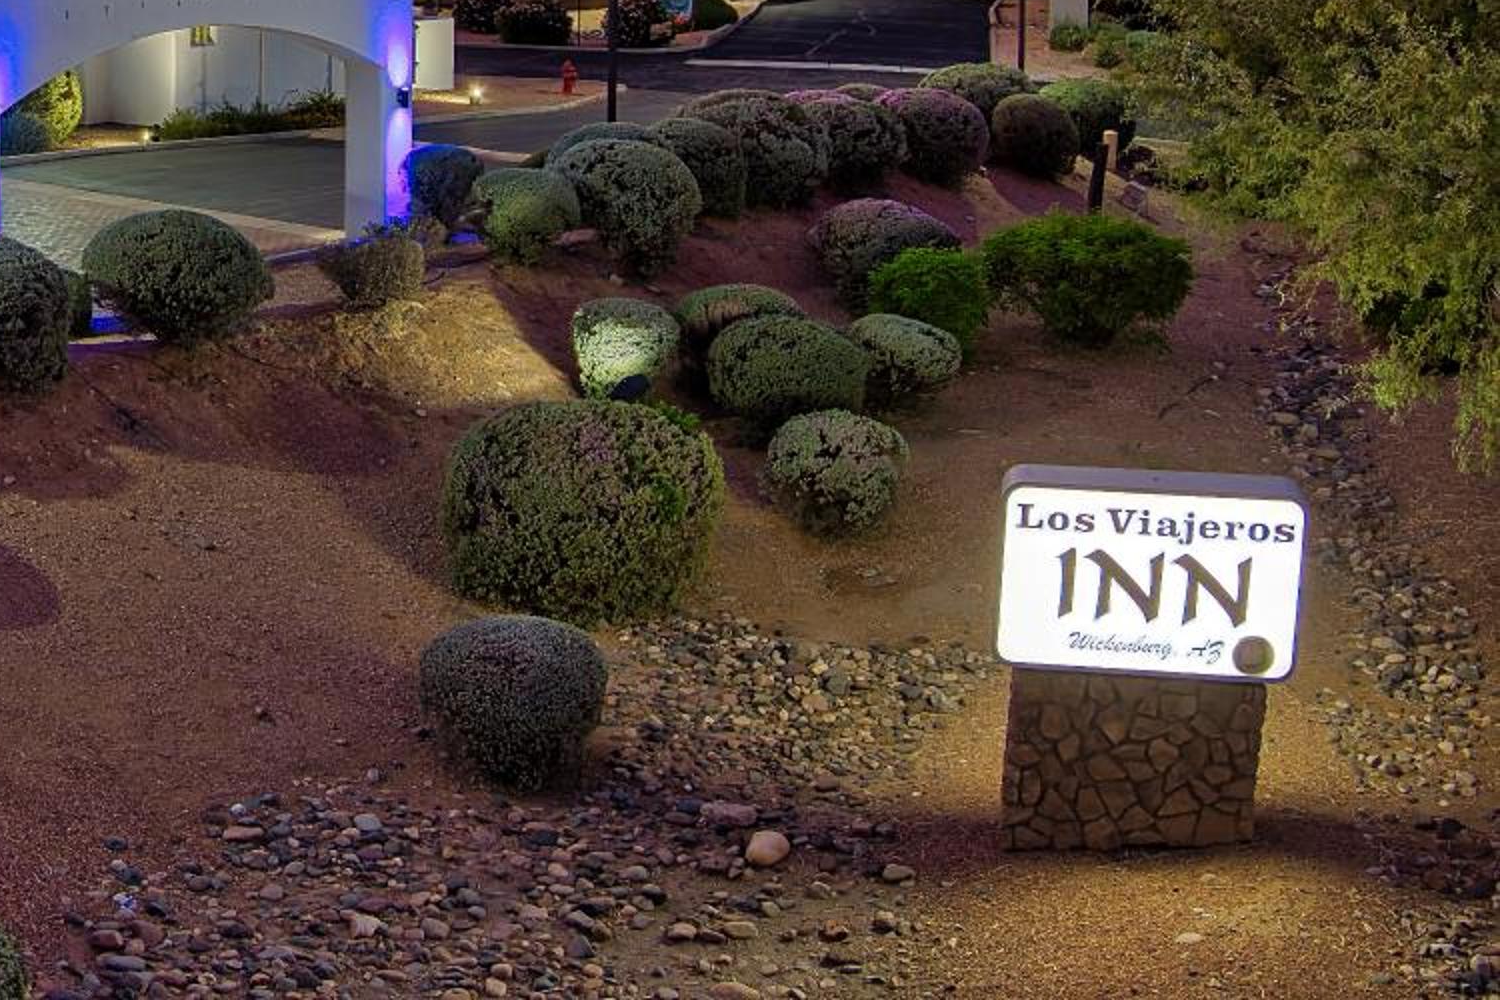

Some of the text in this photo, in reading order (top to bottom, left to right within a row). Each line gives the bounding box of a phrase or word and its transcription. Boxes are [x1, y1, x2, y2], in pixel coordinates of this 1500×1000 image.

[1016, 503, 1296, 545] Los Viajeros
[1055, 547, 1253, 630] INN
